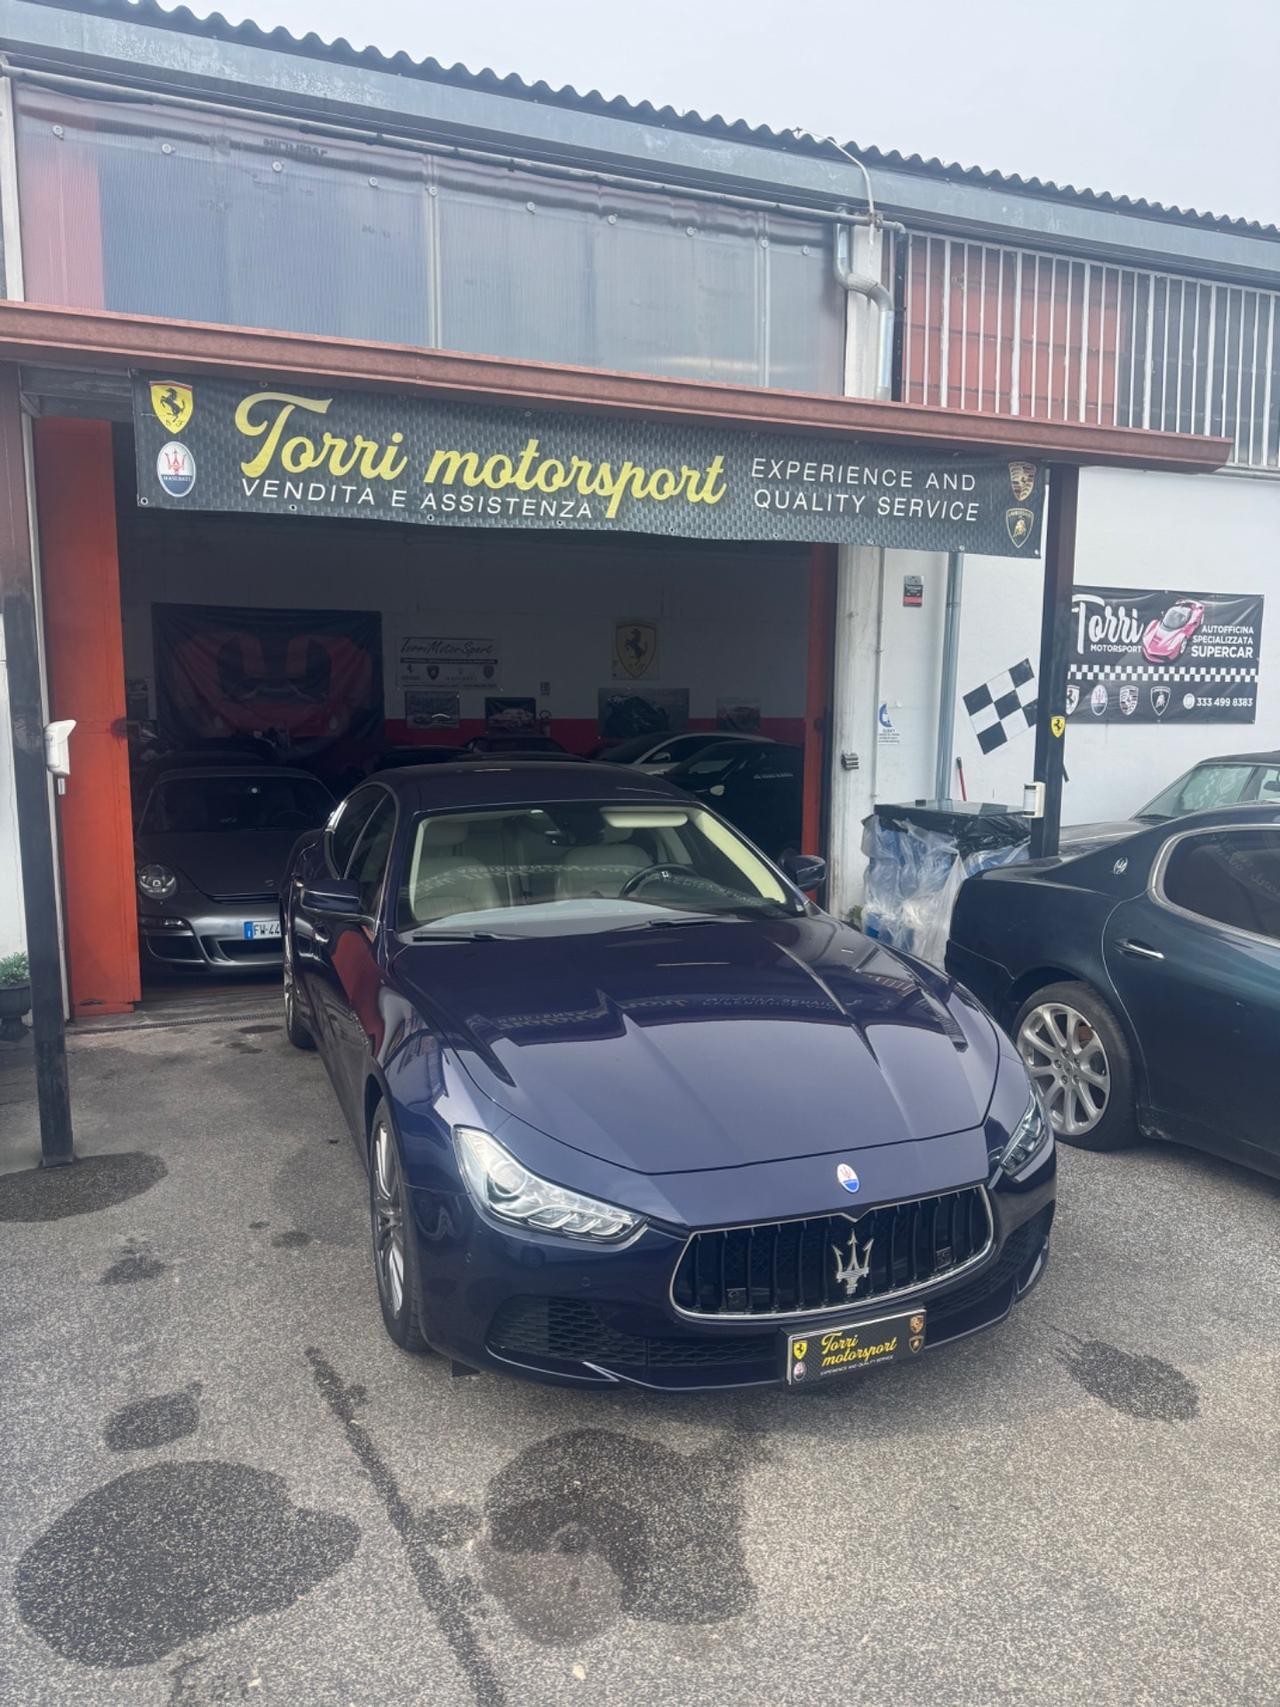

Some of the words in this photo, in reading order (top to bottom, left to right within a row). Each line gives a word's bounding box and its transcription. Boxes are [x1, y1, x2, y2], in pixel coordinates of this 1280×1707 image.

[234, 392, 408, 480] Torri
[423, 438, 728, 519] motorsport
[752, 458, 912, 488] EXPERIENCE
[926, 474, 976, 491] AND
[241, 479, 375, 505] VENDITA
[392, 490, 406, 507] E
[421, 493, 592, 518] ASSISTENZA
[754, 489, 865, 514] QUALITY
[877, 497, 979, 521] SERVICE
[1072, 594, 1144, 654] Torri
[1201, 625, 1254, 635] AUTOFFICINA
[1090, 644, 1142, 653] MOTORSPORT
[1191, 645, 1254, 658] SUPERCAR
[1192, 635, 1254, 645] SPECIALIZZATA
[1196, 697, 1212, 707] 333
[1214, 697, 1231, 707] 499
[821, 1332, 858, 1354] Torri
[821, 1337, 897, 1367] motorsport
